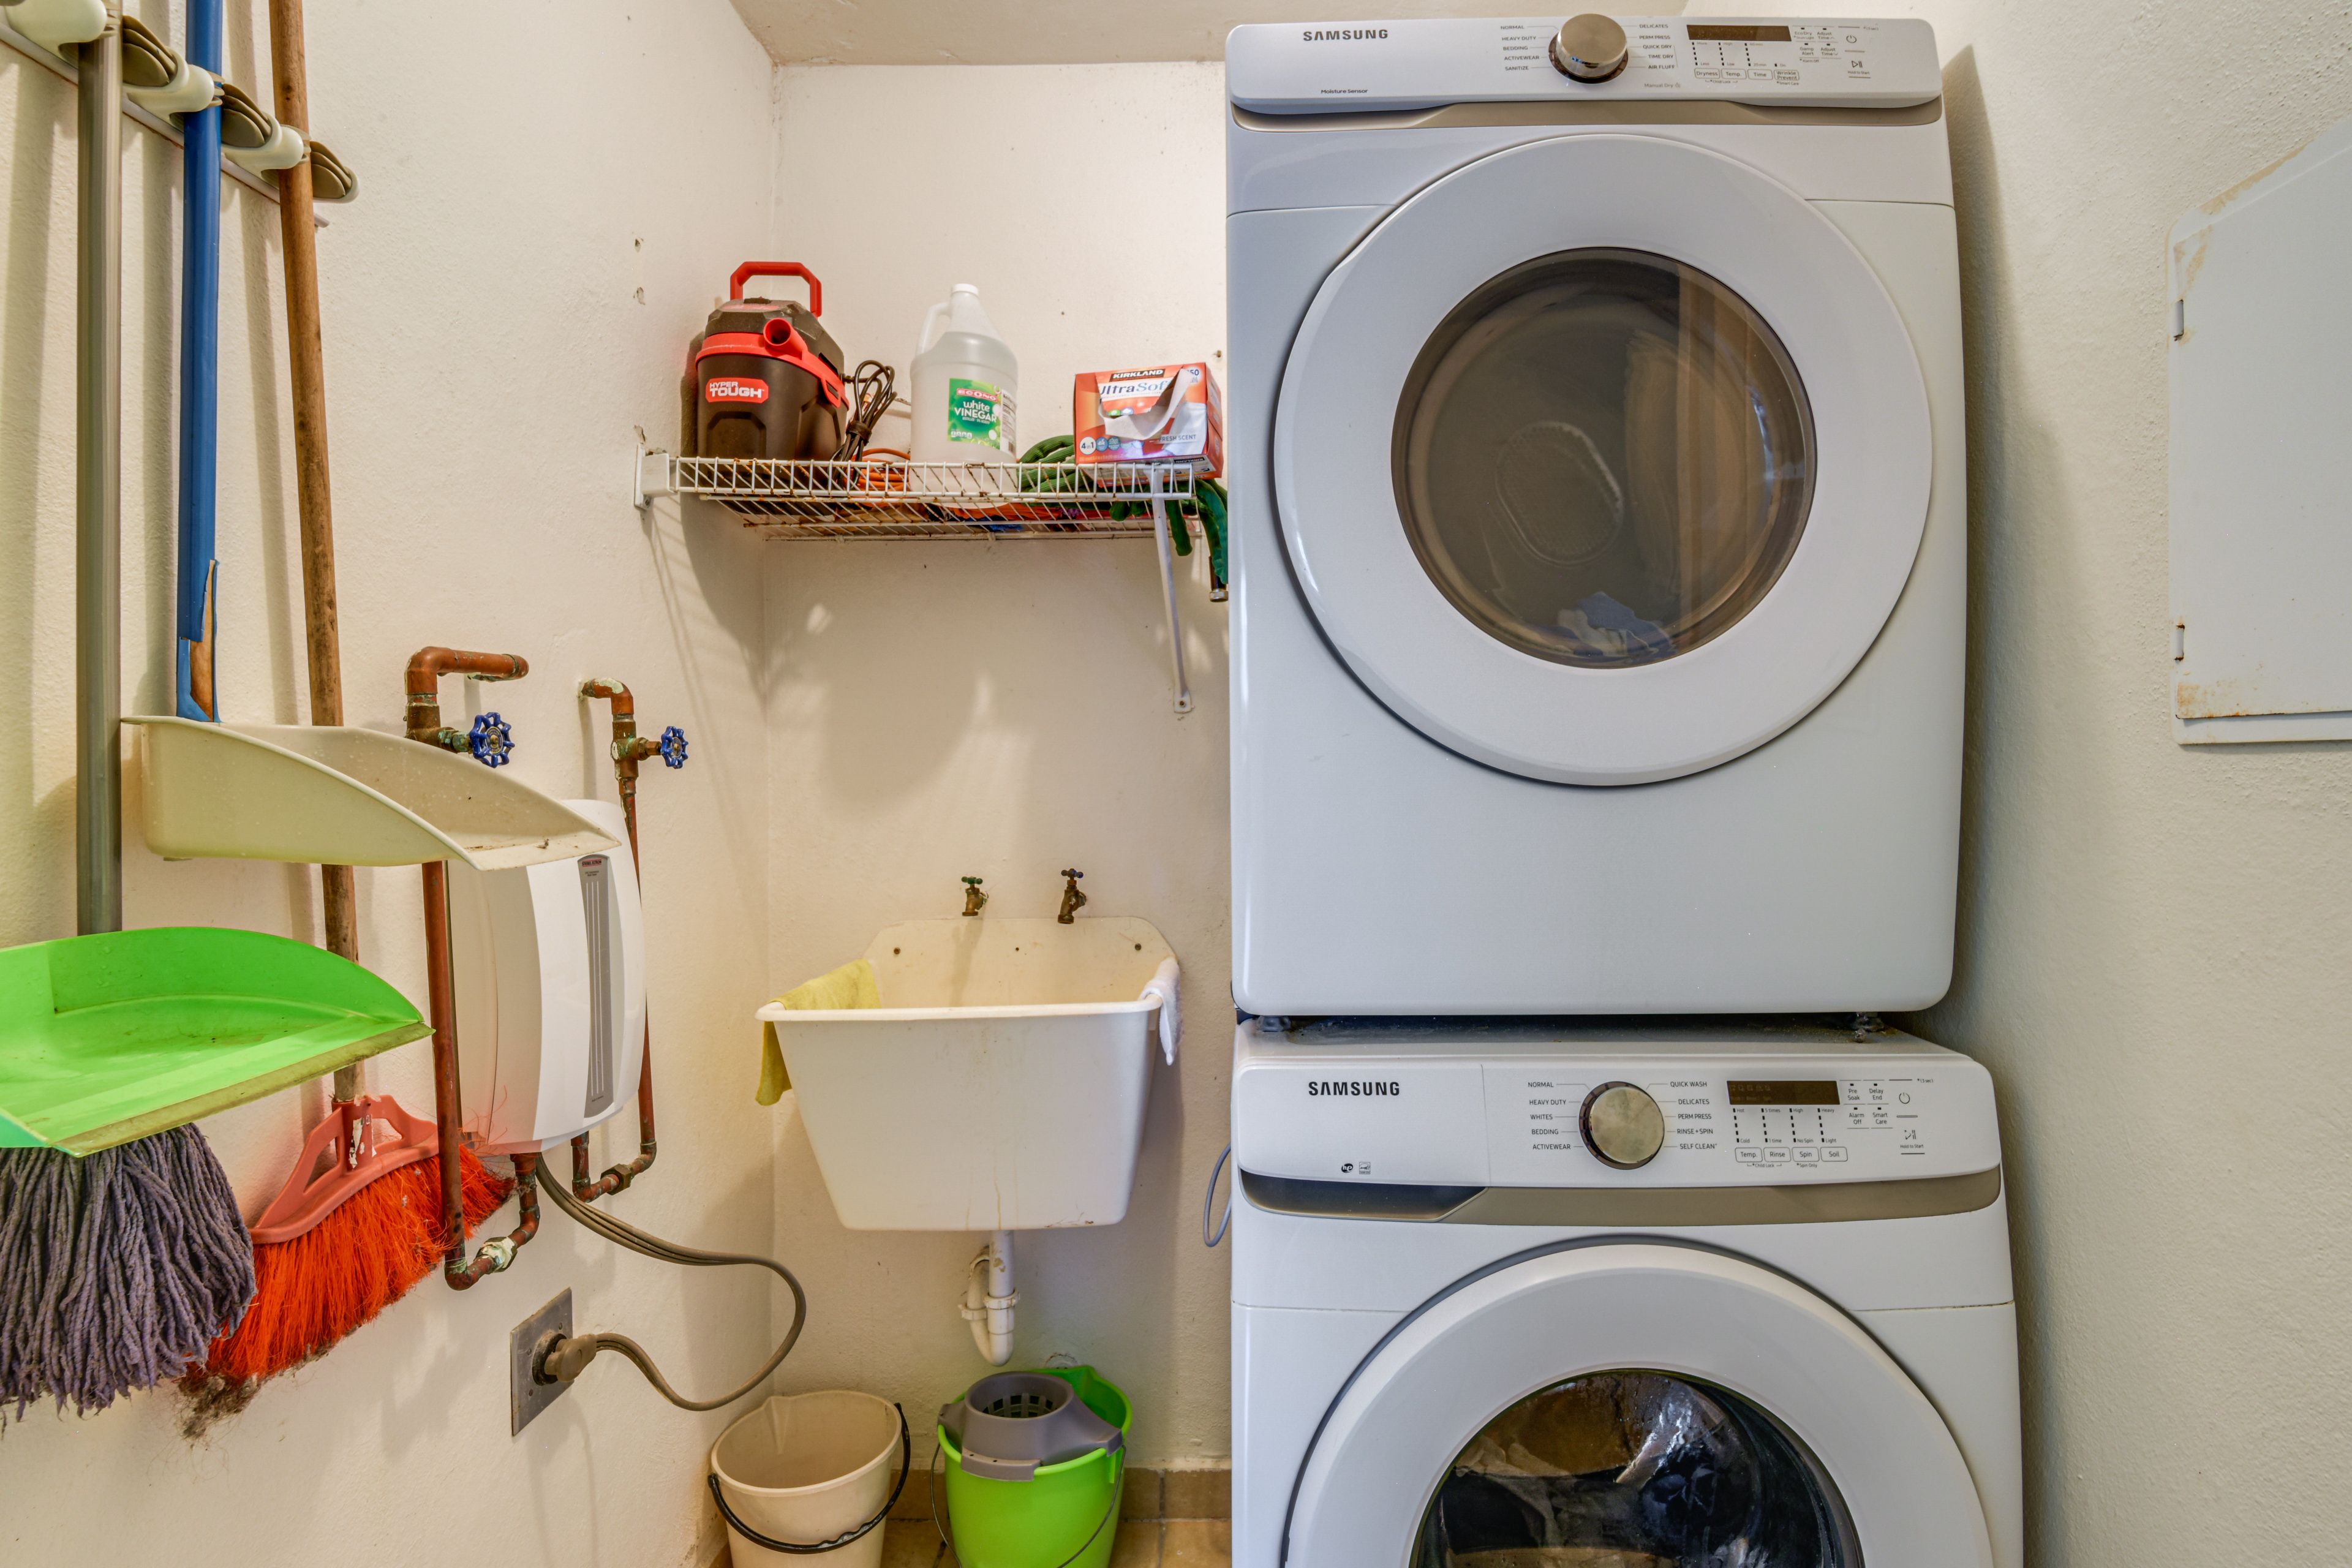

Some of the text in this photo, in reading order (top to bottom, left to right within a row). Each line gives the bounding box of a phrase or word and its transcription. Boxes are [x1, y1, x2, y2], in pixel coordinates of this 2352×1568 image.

[1303, 29, 1388, 41] SAMSUNG
[1113, 369, 1163, 379] KIRKLAND
[709, 387, 762, 398] TOUGH
[958, 390, 996, 401] ECONO
[963, 400, 990, 412] white
[954, 407, 997, 423] VINEGAR
[1308, 1082, 1400, 1096] SAMSUNG
